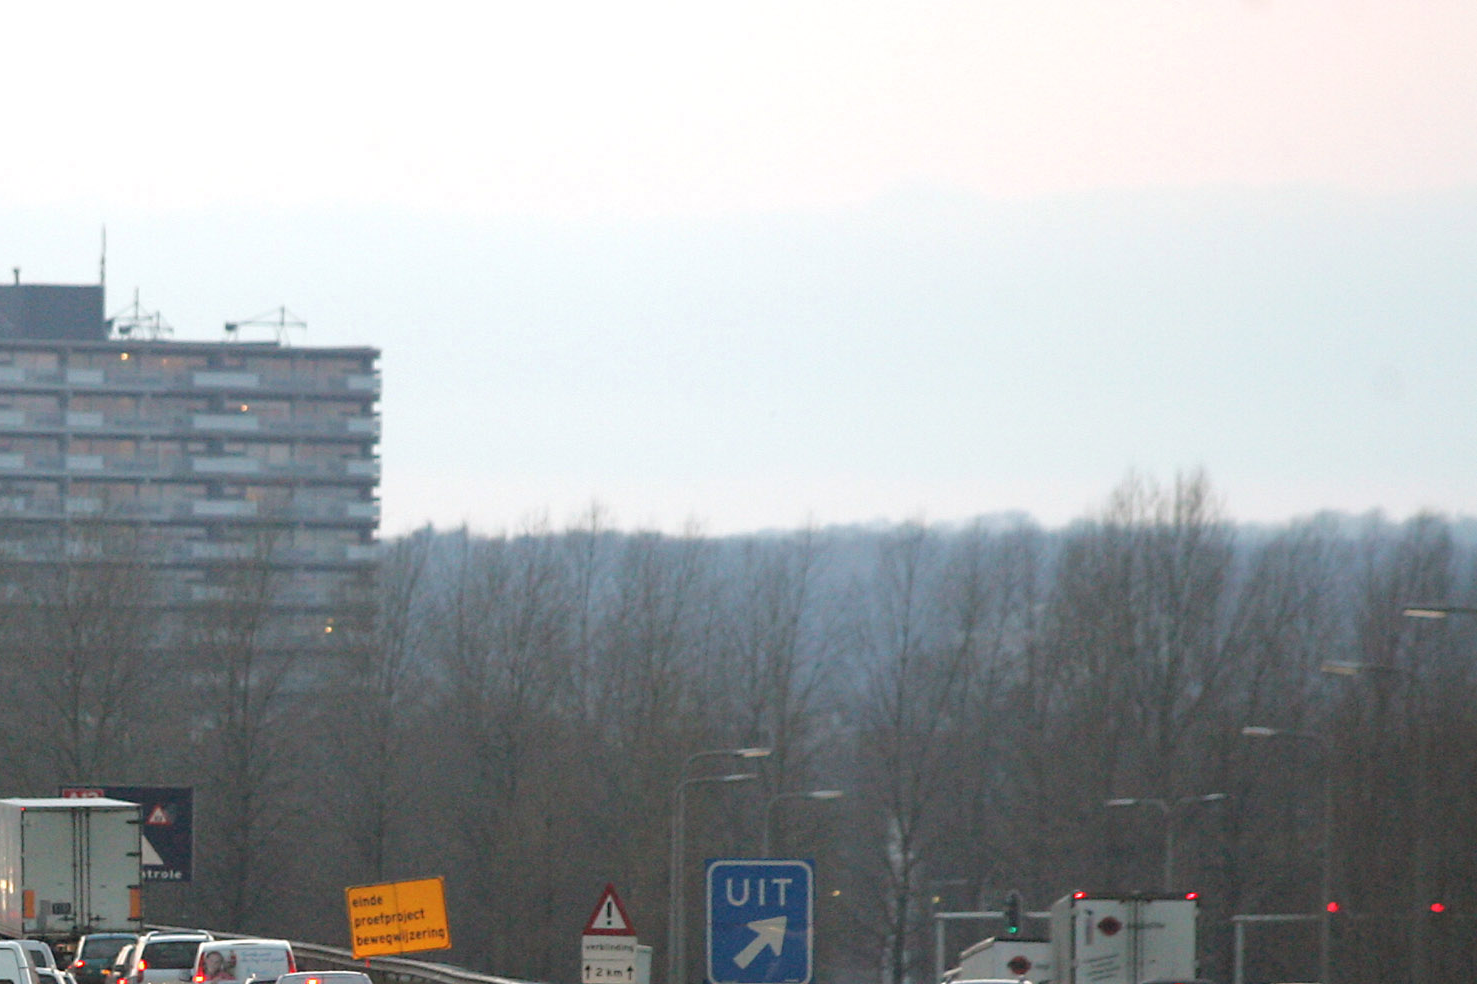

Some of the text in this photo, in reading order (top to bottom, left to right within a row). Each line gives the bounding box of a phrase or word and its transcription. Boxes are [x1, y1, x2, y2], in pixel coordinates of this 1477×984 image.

[726, 878, 793, 906] UIT
[352, 895, 383, 907] einde
[354, 908, 425, 929] proefproject
[586, 944, 634, 953] verblinding
[596, 967, 623, 977] 2 km
